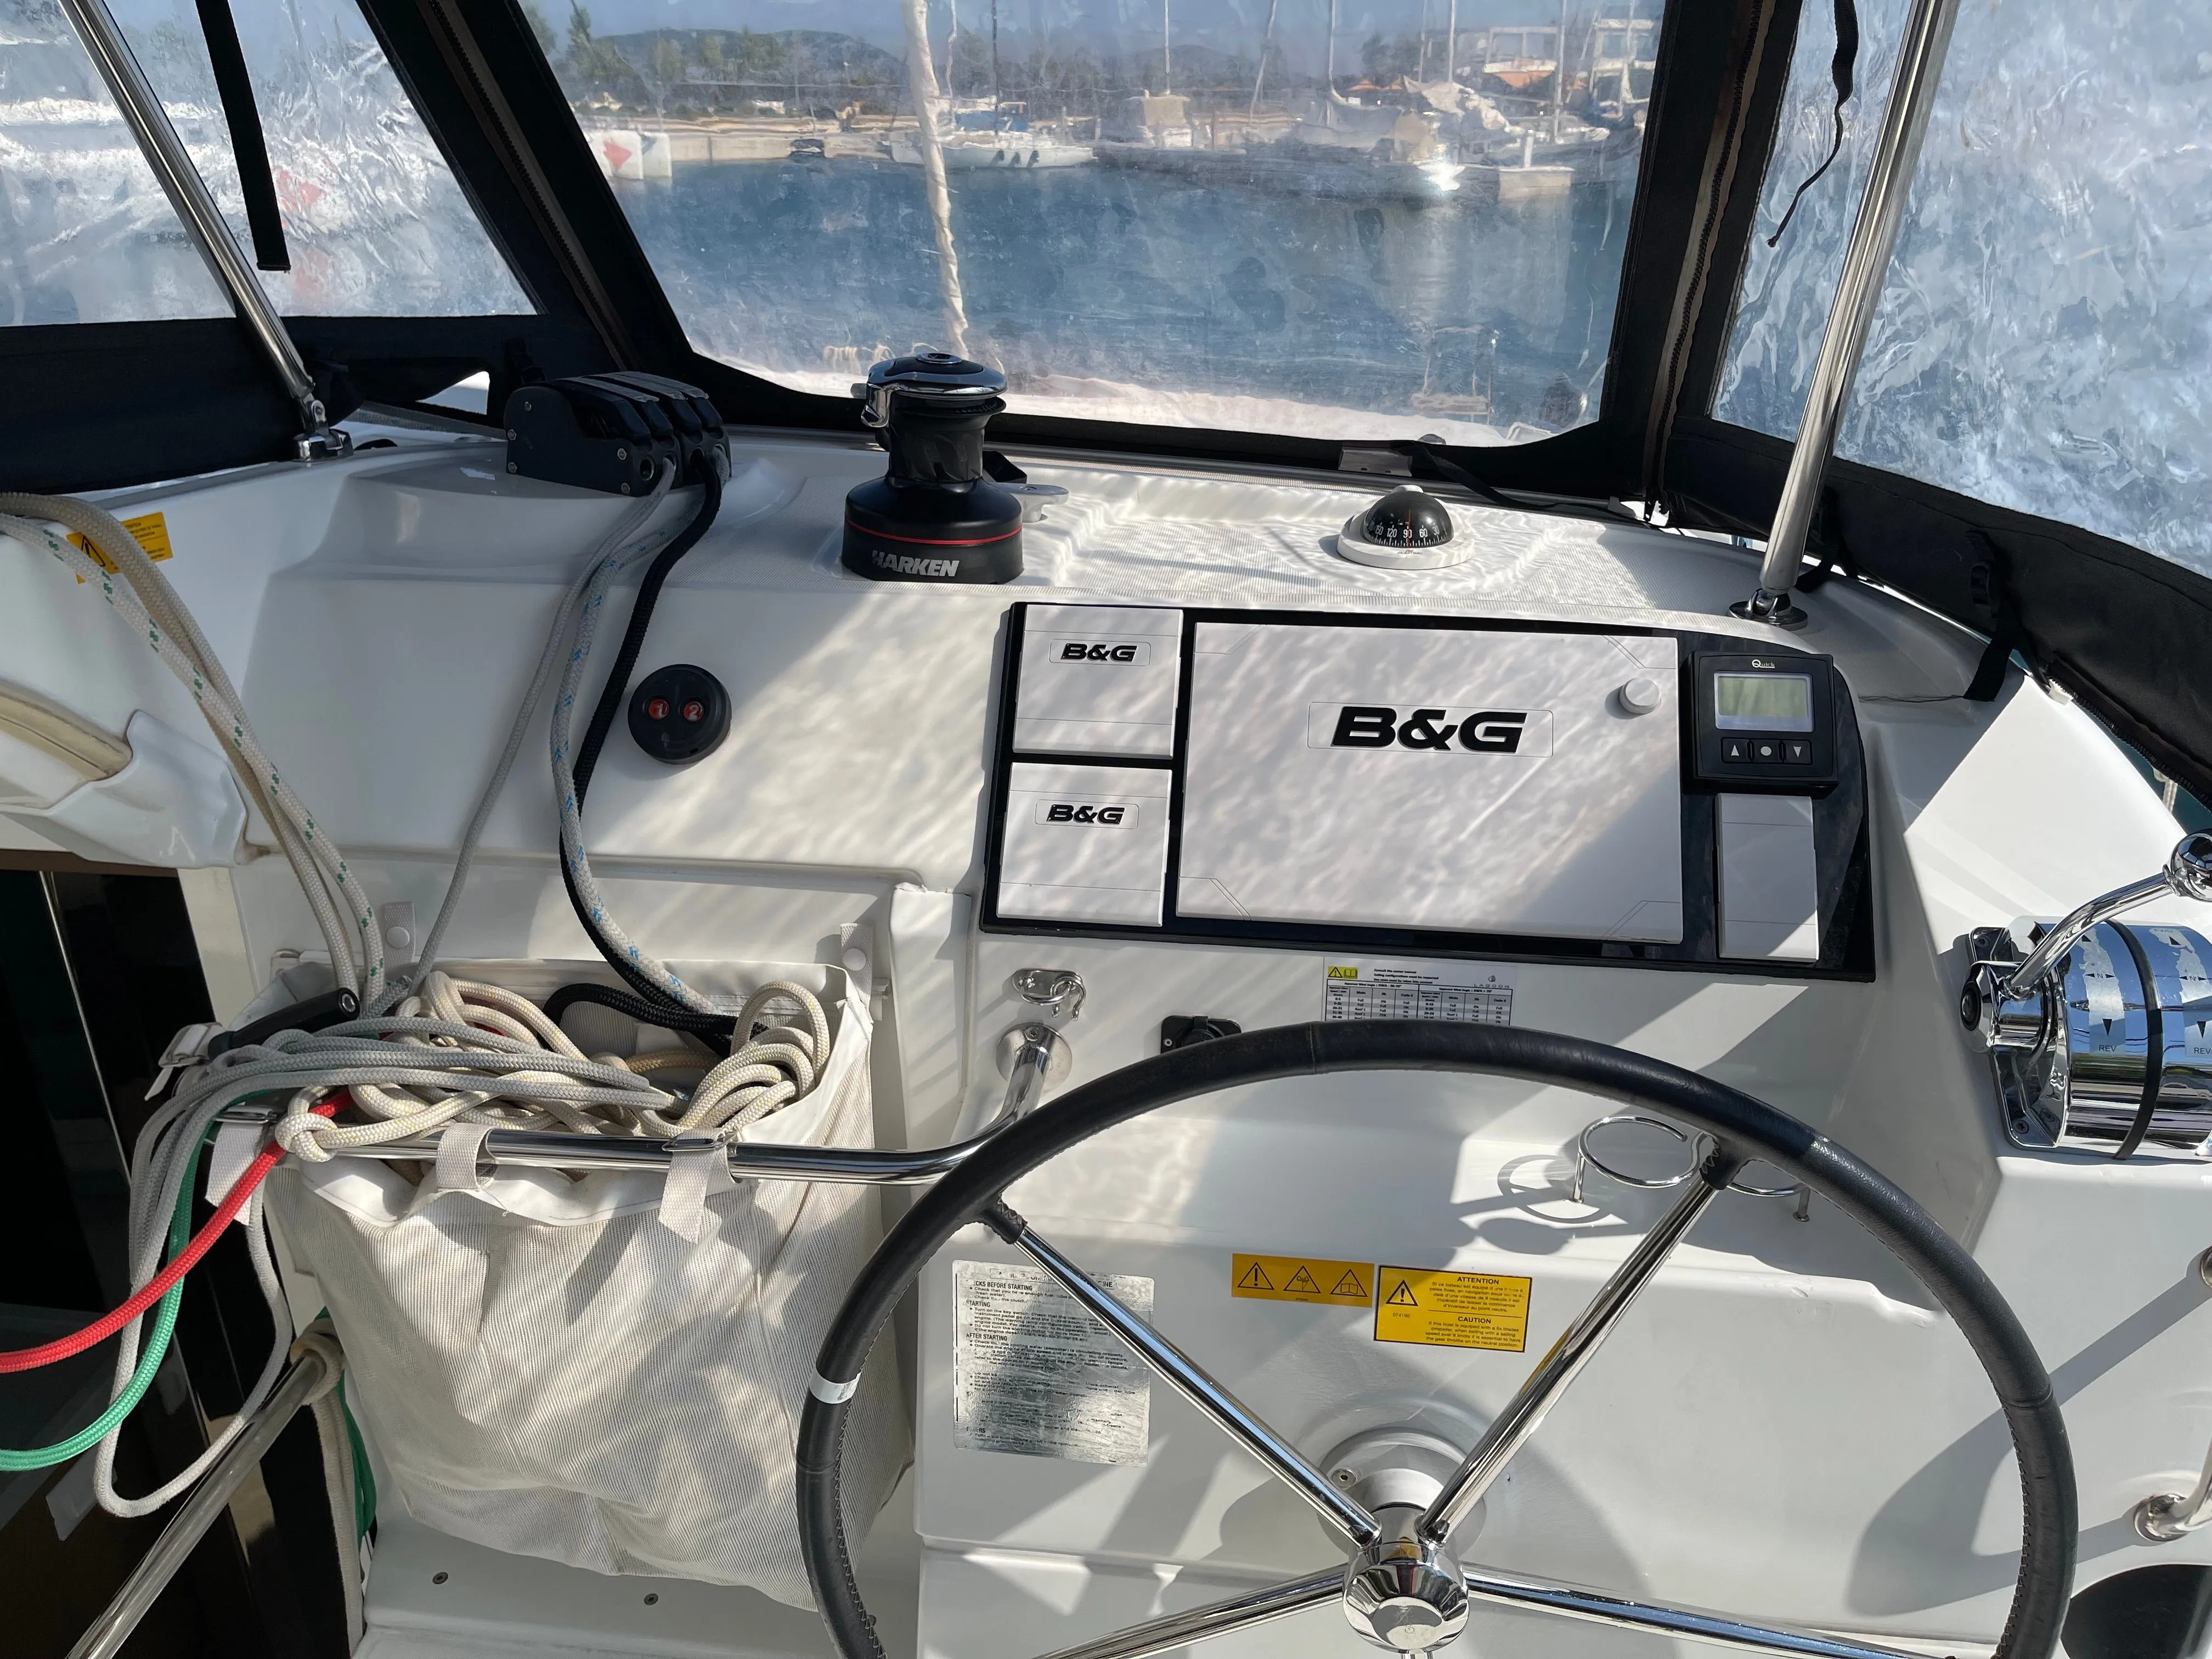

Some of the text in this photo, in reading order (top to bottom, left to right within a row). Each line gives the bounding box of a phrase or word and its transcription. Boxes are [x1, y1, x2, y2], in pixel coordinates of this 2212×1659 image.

[1387, 527, 1397, 538] 120
[1403, 529, 1412, 539] 90
[1419, 528, 1428, 538] 60
[1432, 525, 1440, 536] 30
[872, 550, 960, 577] HARKEN
[1060, 642, 1137, 663] B&G
[1752, 659, 1775, 669] Quick
[657, 703, 700, 720] 1 2
[1331, 706, 1527, 754] B&G
[1046, 803, 1125, 826] B&G
